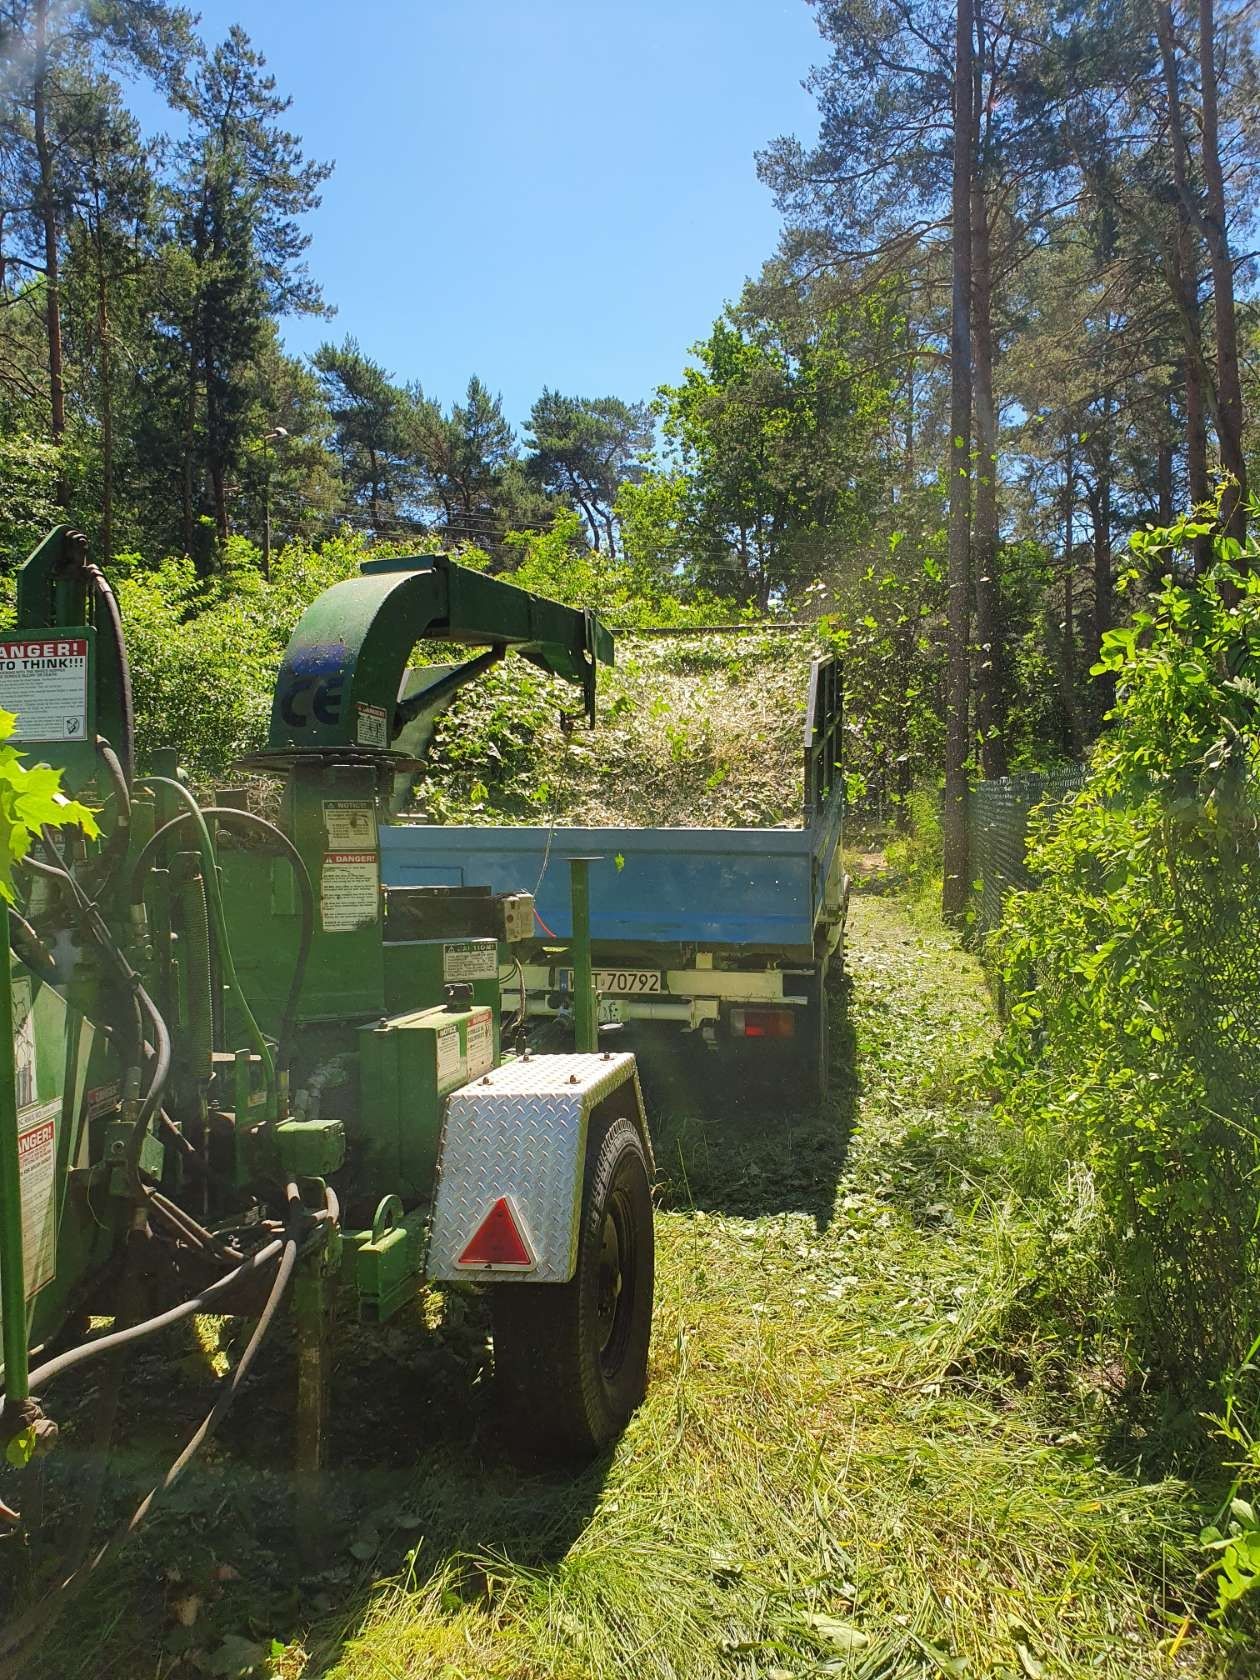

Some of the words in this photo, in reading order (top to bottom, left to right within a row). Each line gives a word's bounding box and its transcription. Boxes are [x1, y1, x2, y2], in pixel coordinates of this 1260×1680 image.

[0, 643, 78, 659] ANGER!
[0, 661, 16, 671] TO
[21, 658, 83, 670] THINK!!!
[607, 972, 659, 992] 70792
[19, 1126, 52, 1153] NGER!
